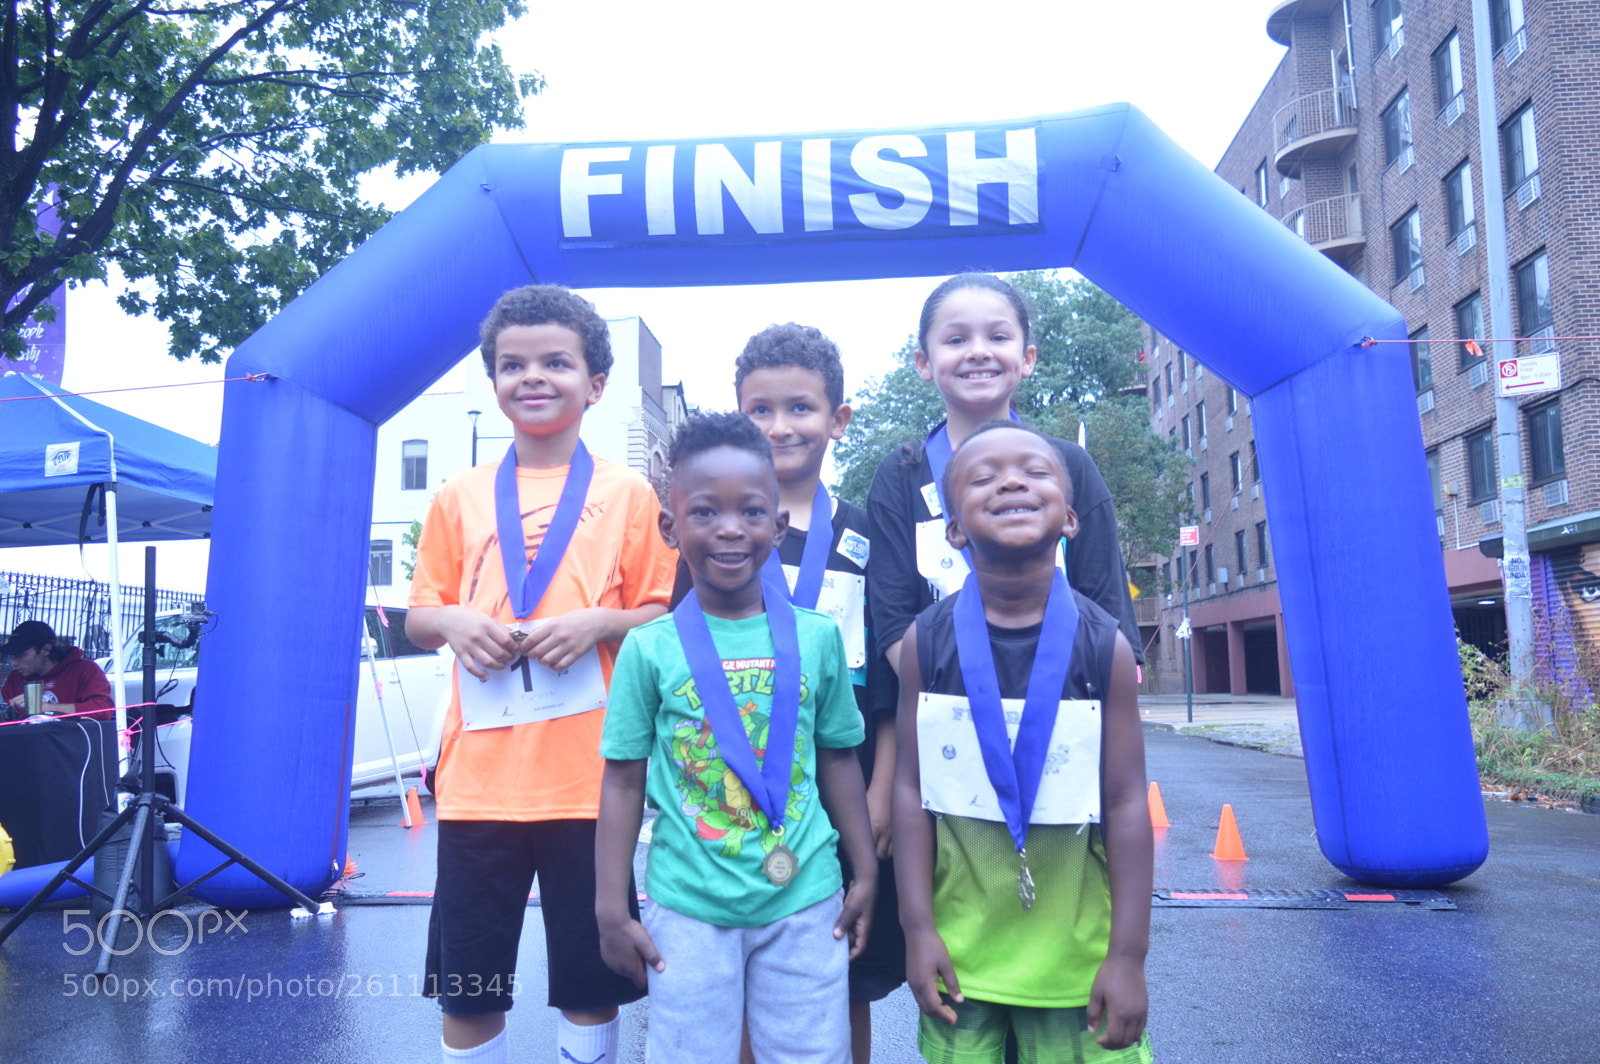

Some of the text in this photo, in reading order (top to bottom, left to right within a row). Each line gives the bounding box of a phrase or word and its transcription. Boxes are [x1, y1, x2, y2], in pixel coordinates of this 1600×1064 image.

[560, 128, 1039, 237] FINISH
[510, 655, 533, 693] 1
[736, 659, 771, 669] MUTANT
[672, 667, 809, 711] TRTL
